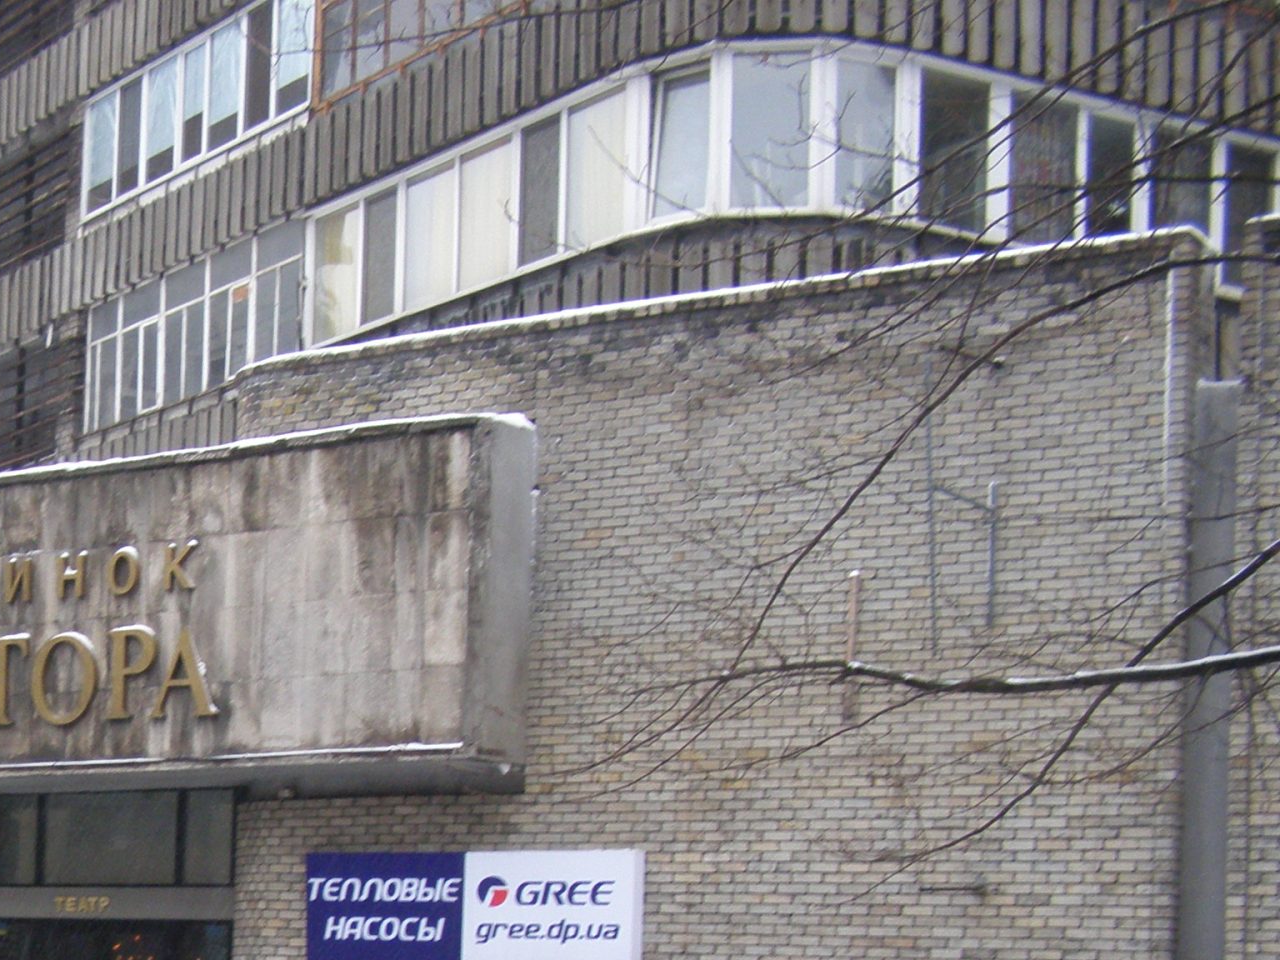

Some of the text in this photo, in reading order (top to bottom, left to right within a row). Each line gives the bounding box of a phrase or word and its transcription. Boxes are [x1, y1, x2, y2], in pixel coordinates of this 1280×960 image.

[308, 877, 461, 903] ТЕПЛОВЫЕ
[514, 880, 616, 906] GREE
[54, 895, 111, 912] ТЕАТР
[323, 916, 445, 943] НАСОСЫ
[475, 918, 620, 944] gree.dp.ua
